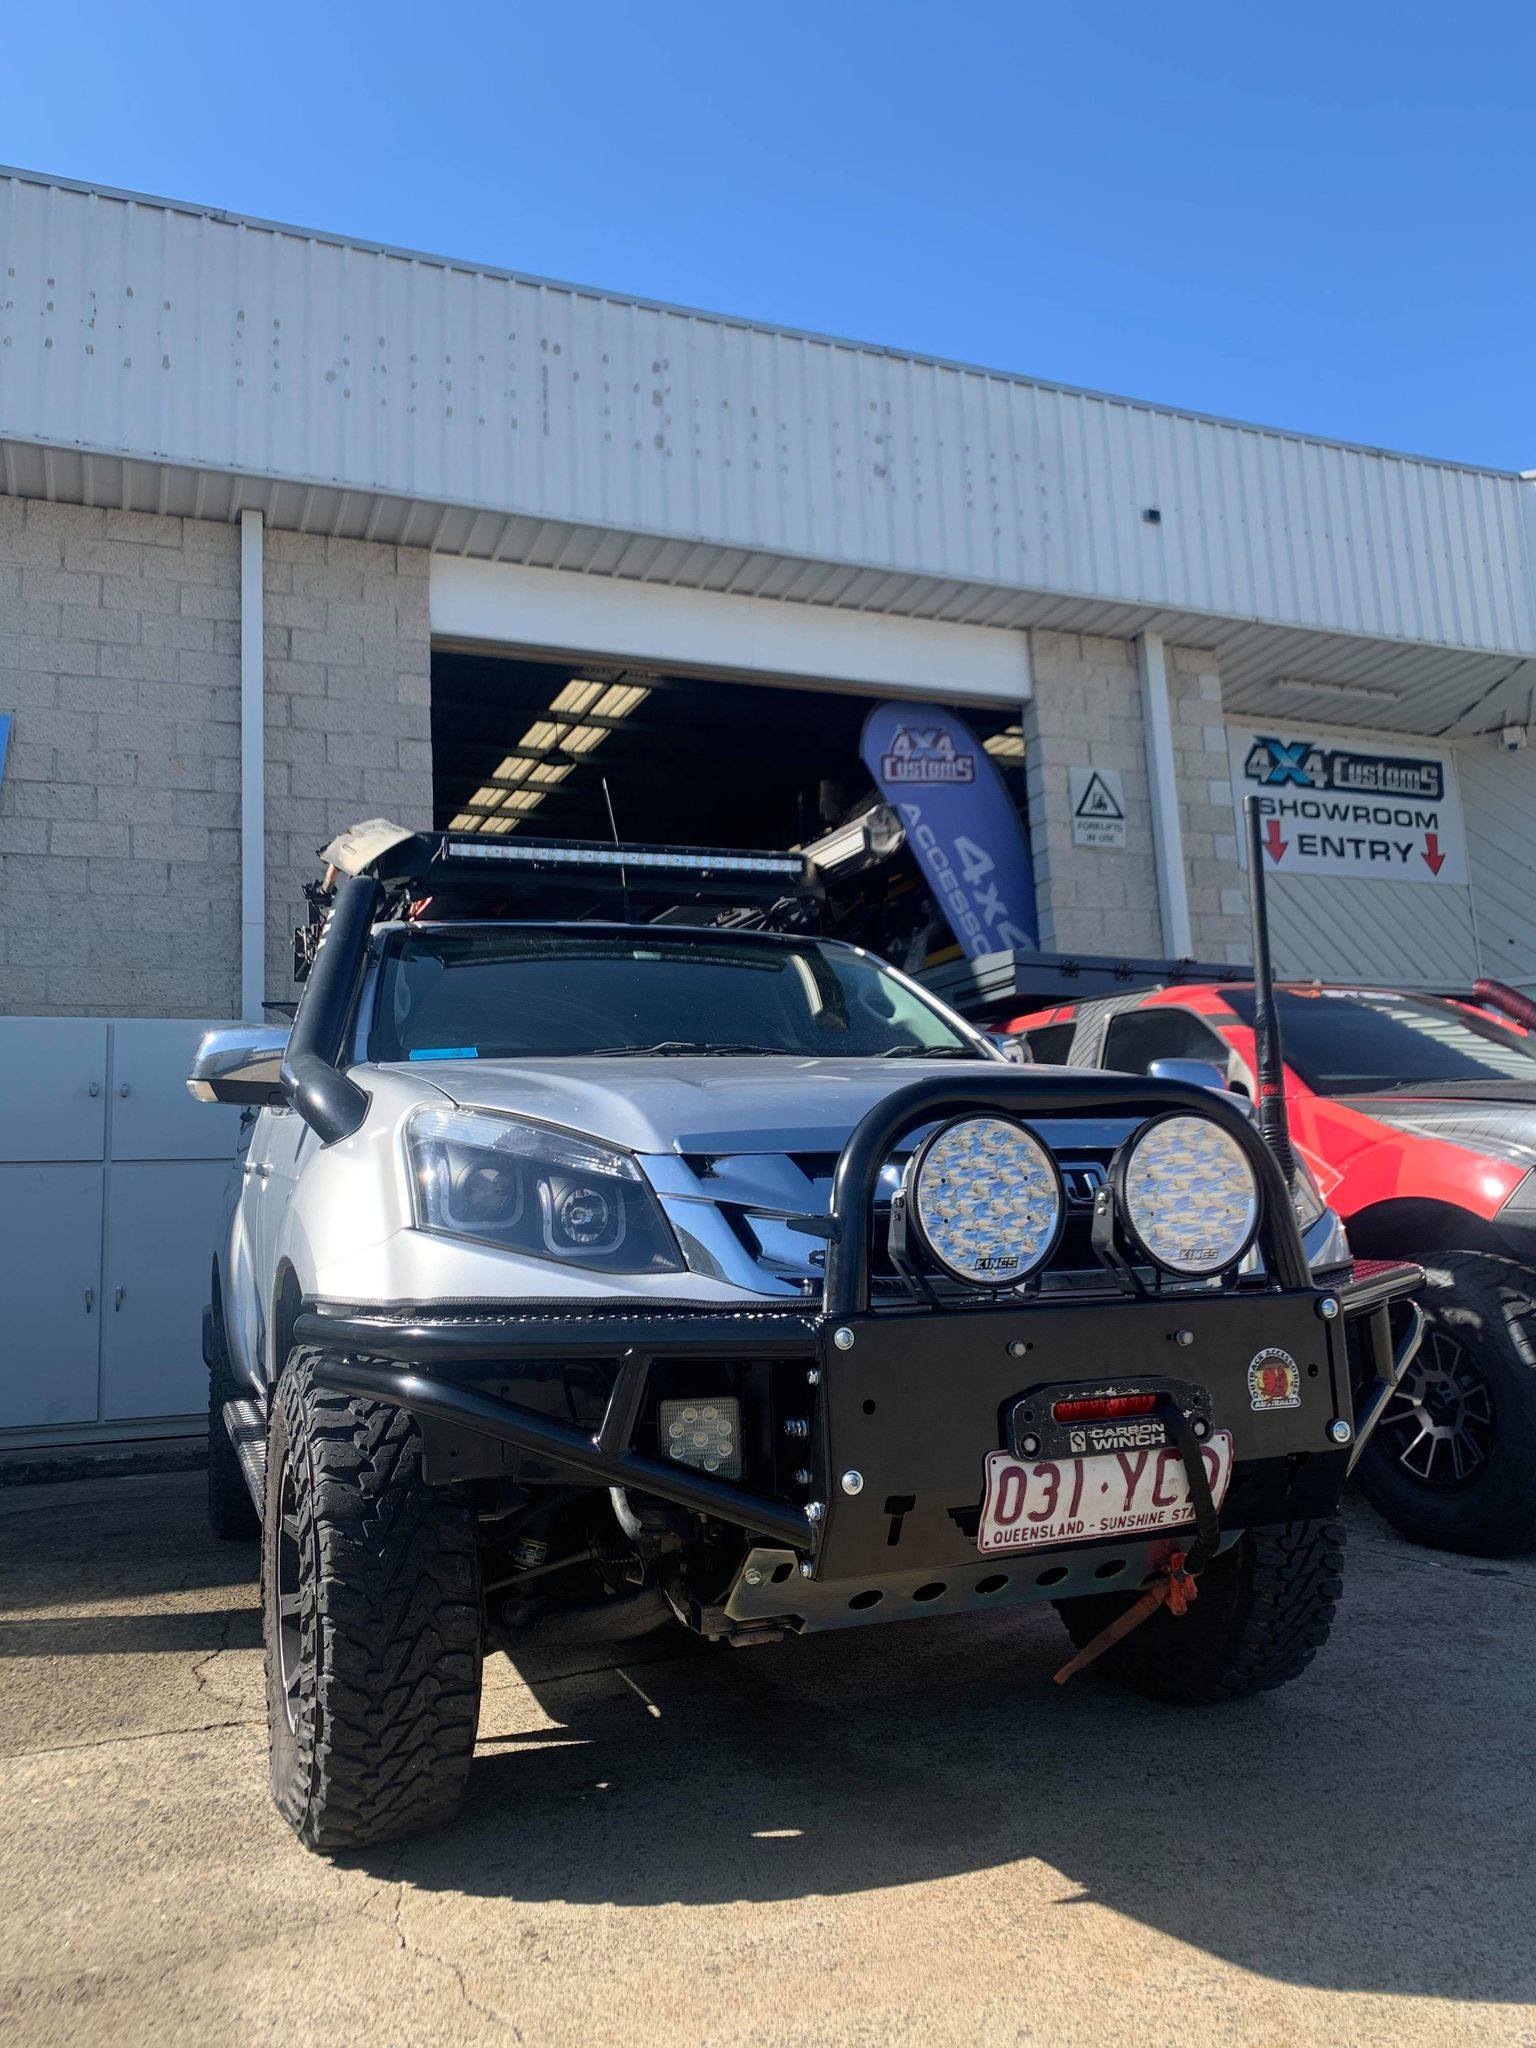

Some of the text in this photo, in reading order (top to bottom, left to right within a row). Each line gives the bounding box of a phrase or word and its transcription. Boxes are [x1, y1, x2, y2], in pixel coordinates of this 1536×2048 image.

[1259, 797, 1440, 831] SHOWROOM
[1297, 834, 1414, 864] ENTRY
[901, 803, 992, 955] ACCESSO
[974, 1256, 1019, 1270] KINGS
[1178, 1248, 1219, 1261] KINGS
[1091, 1423, 1165, 1438] CARBON
[1093, 1433, 1166, 1450] WINCH
[993, 1520, 1085, 1545] QUEENSLAND
[1100, 1511, 1166, 1531] SUNSHINE
[1171, 1506, 1195, 1521] STA
